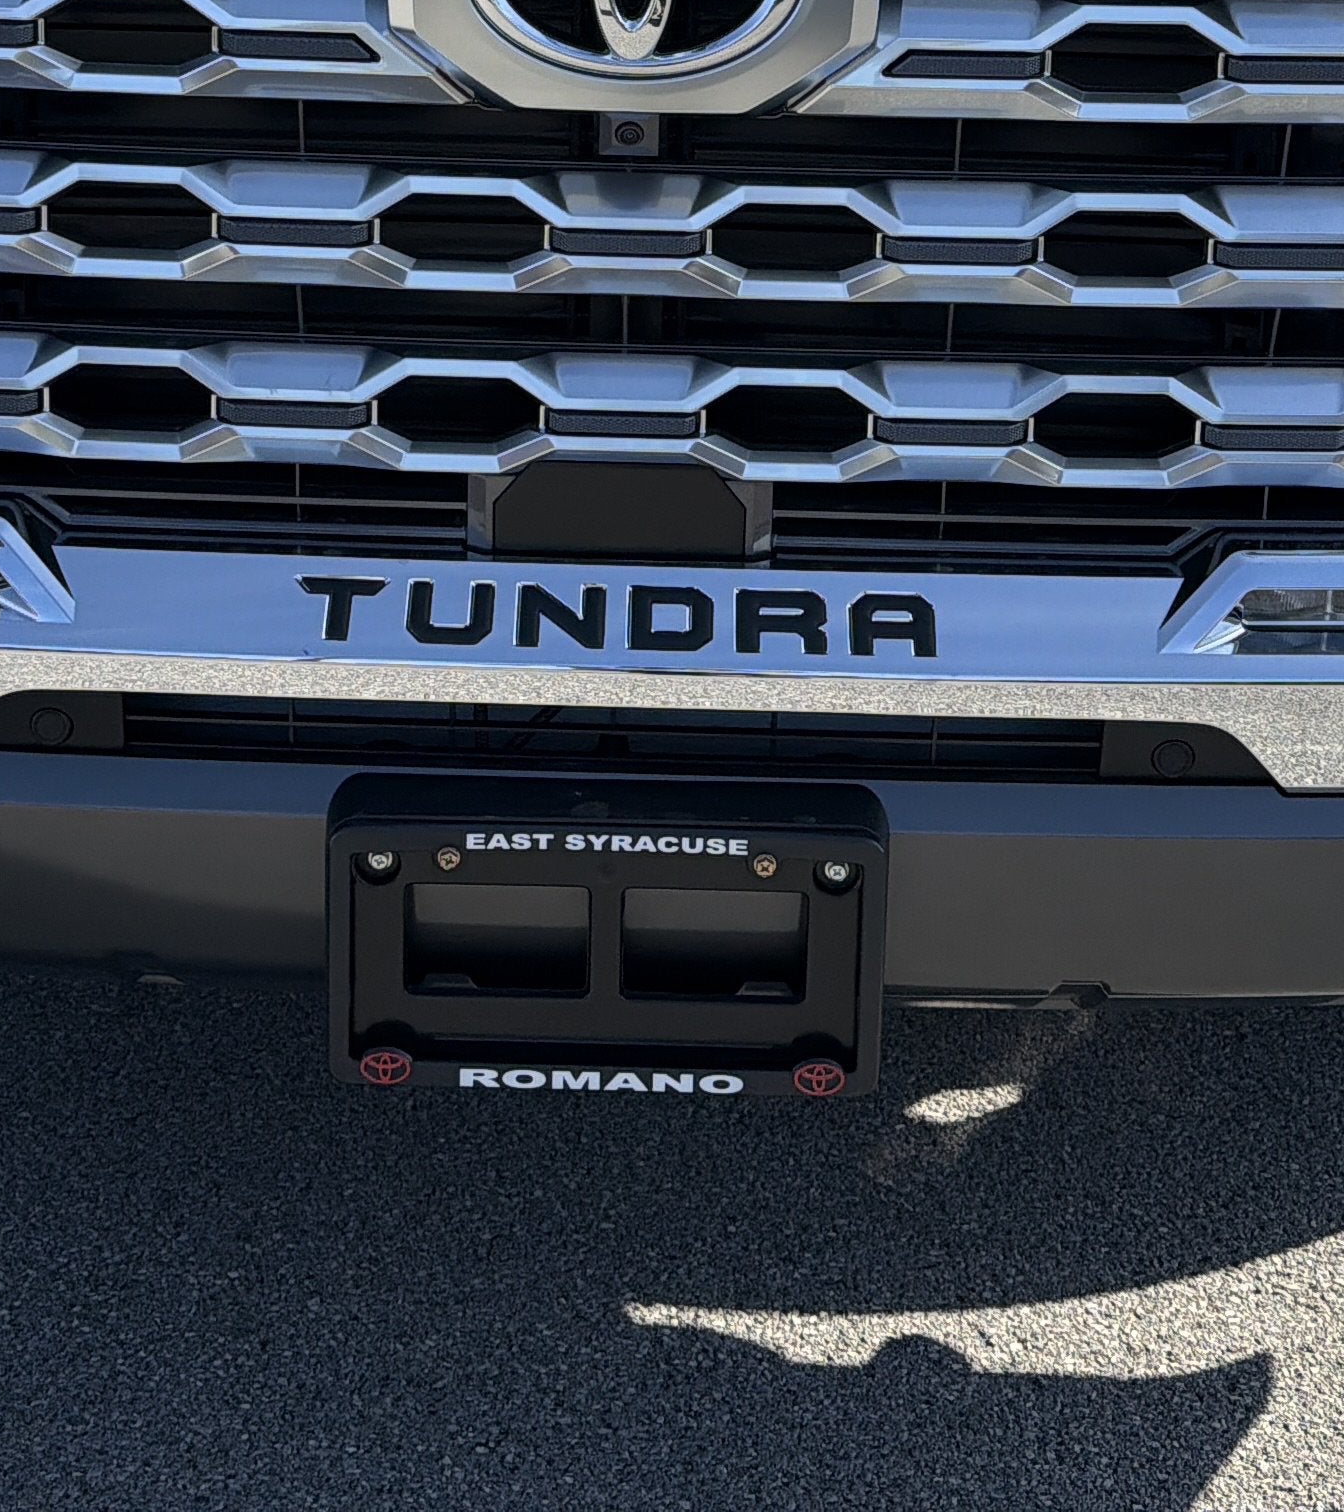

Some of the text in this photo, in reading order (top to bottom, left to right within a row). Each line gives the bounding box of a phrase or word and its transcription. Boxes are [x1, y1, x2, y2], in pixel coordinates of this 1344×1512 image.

[293, 574, 937, 657] TUNDRA
[465, 832, 750, 856] EAST SYRACUSE
[458, 1067, 745, 1095] ROMANO
